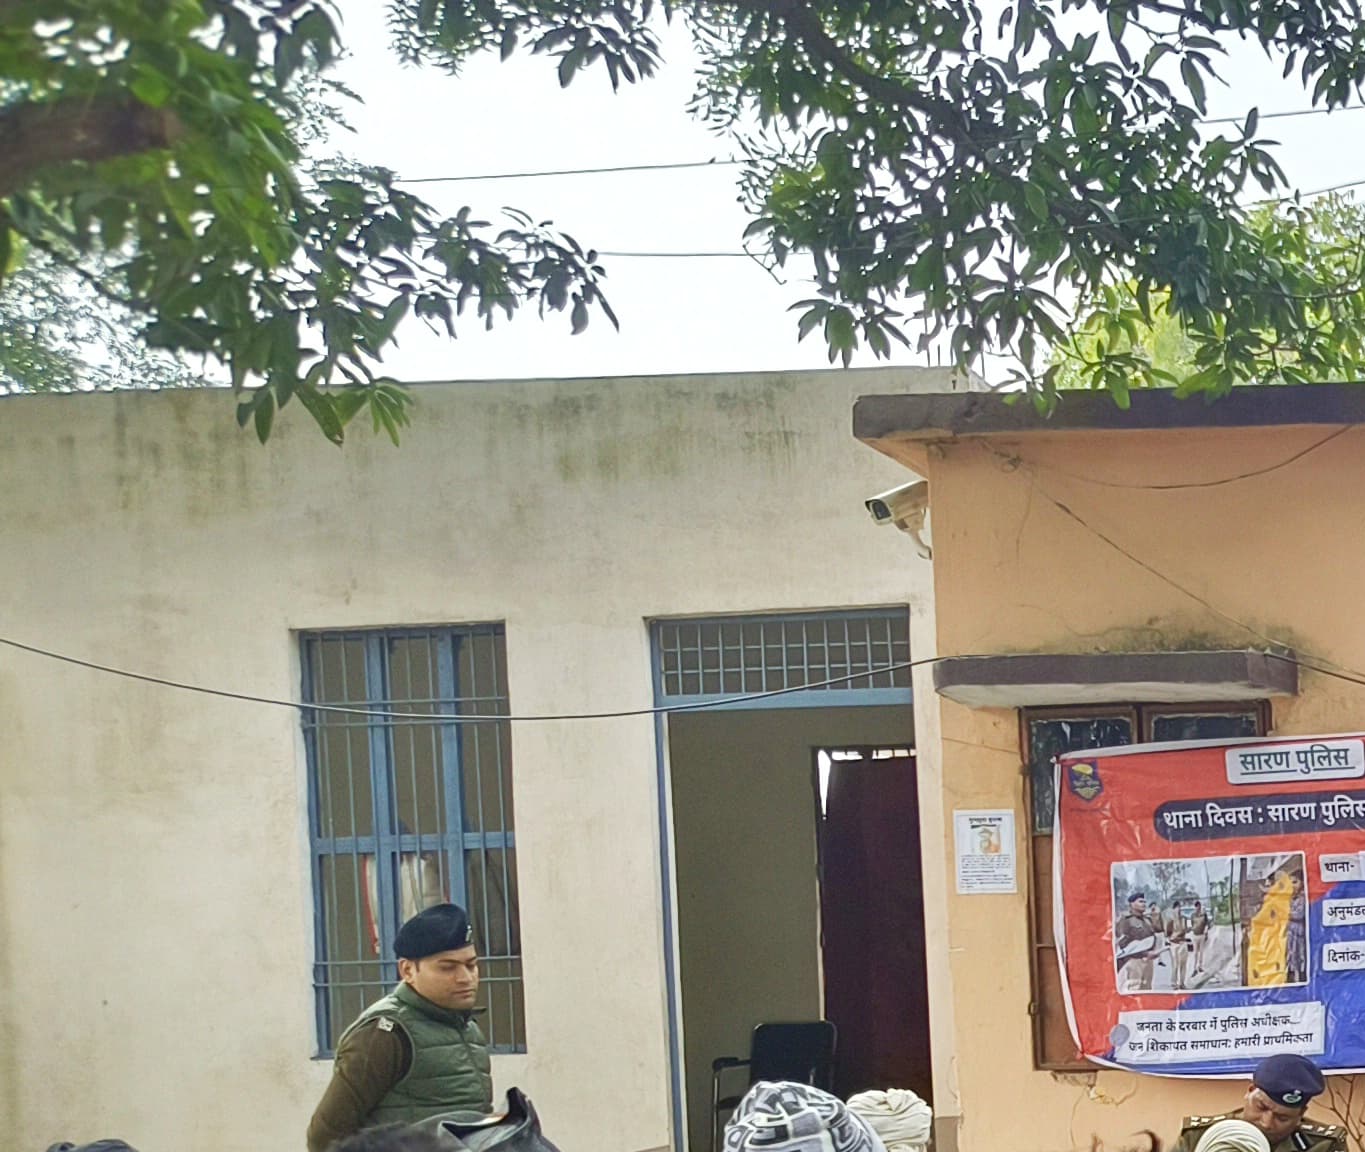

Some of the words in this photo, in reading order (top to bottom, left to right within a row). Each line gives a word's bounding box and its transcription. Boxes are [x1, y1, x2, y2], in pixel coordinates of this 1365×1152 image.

[1240, 751, 1290, 771] सारण
[1297, 745, 1350, 773] पुलिस
[1164, 811, 1203, 830] थाना
[1207, 805, 1253, 828] दिवस
[1267, 804, 1316, 823] सारण
[1137, 1021, 1162, 1032] जनता
[1166, 1018, 1176, 1031] के
[1209, 1016, 1217, 1030] में
[1220, 1015, 1248, 1033] पुलिस
[1251, 1012, 1291, 1028] अधीक्षक
[1234, 1034, 1260, 1050] हमारी
[1263, 1030, 1314, 1047] प्राथमिकता
